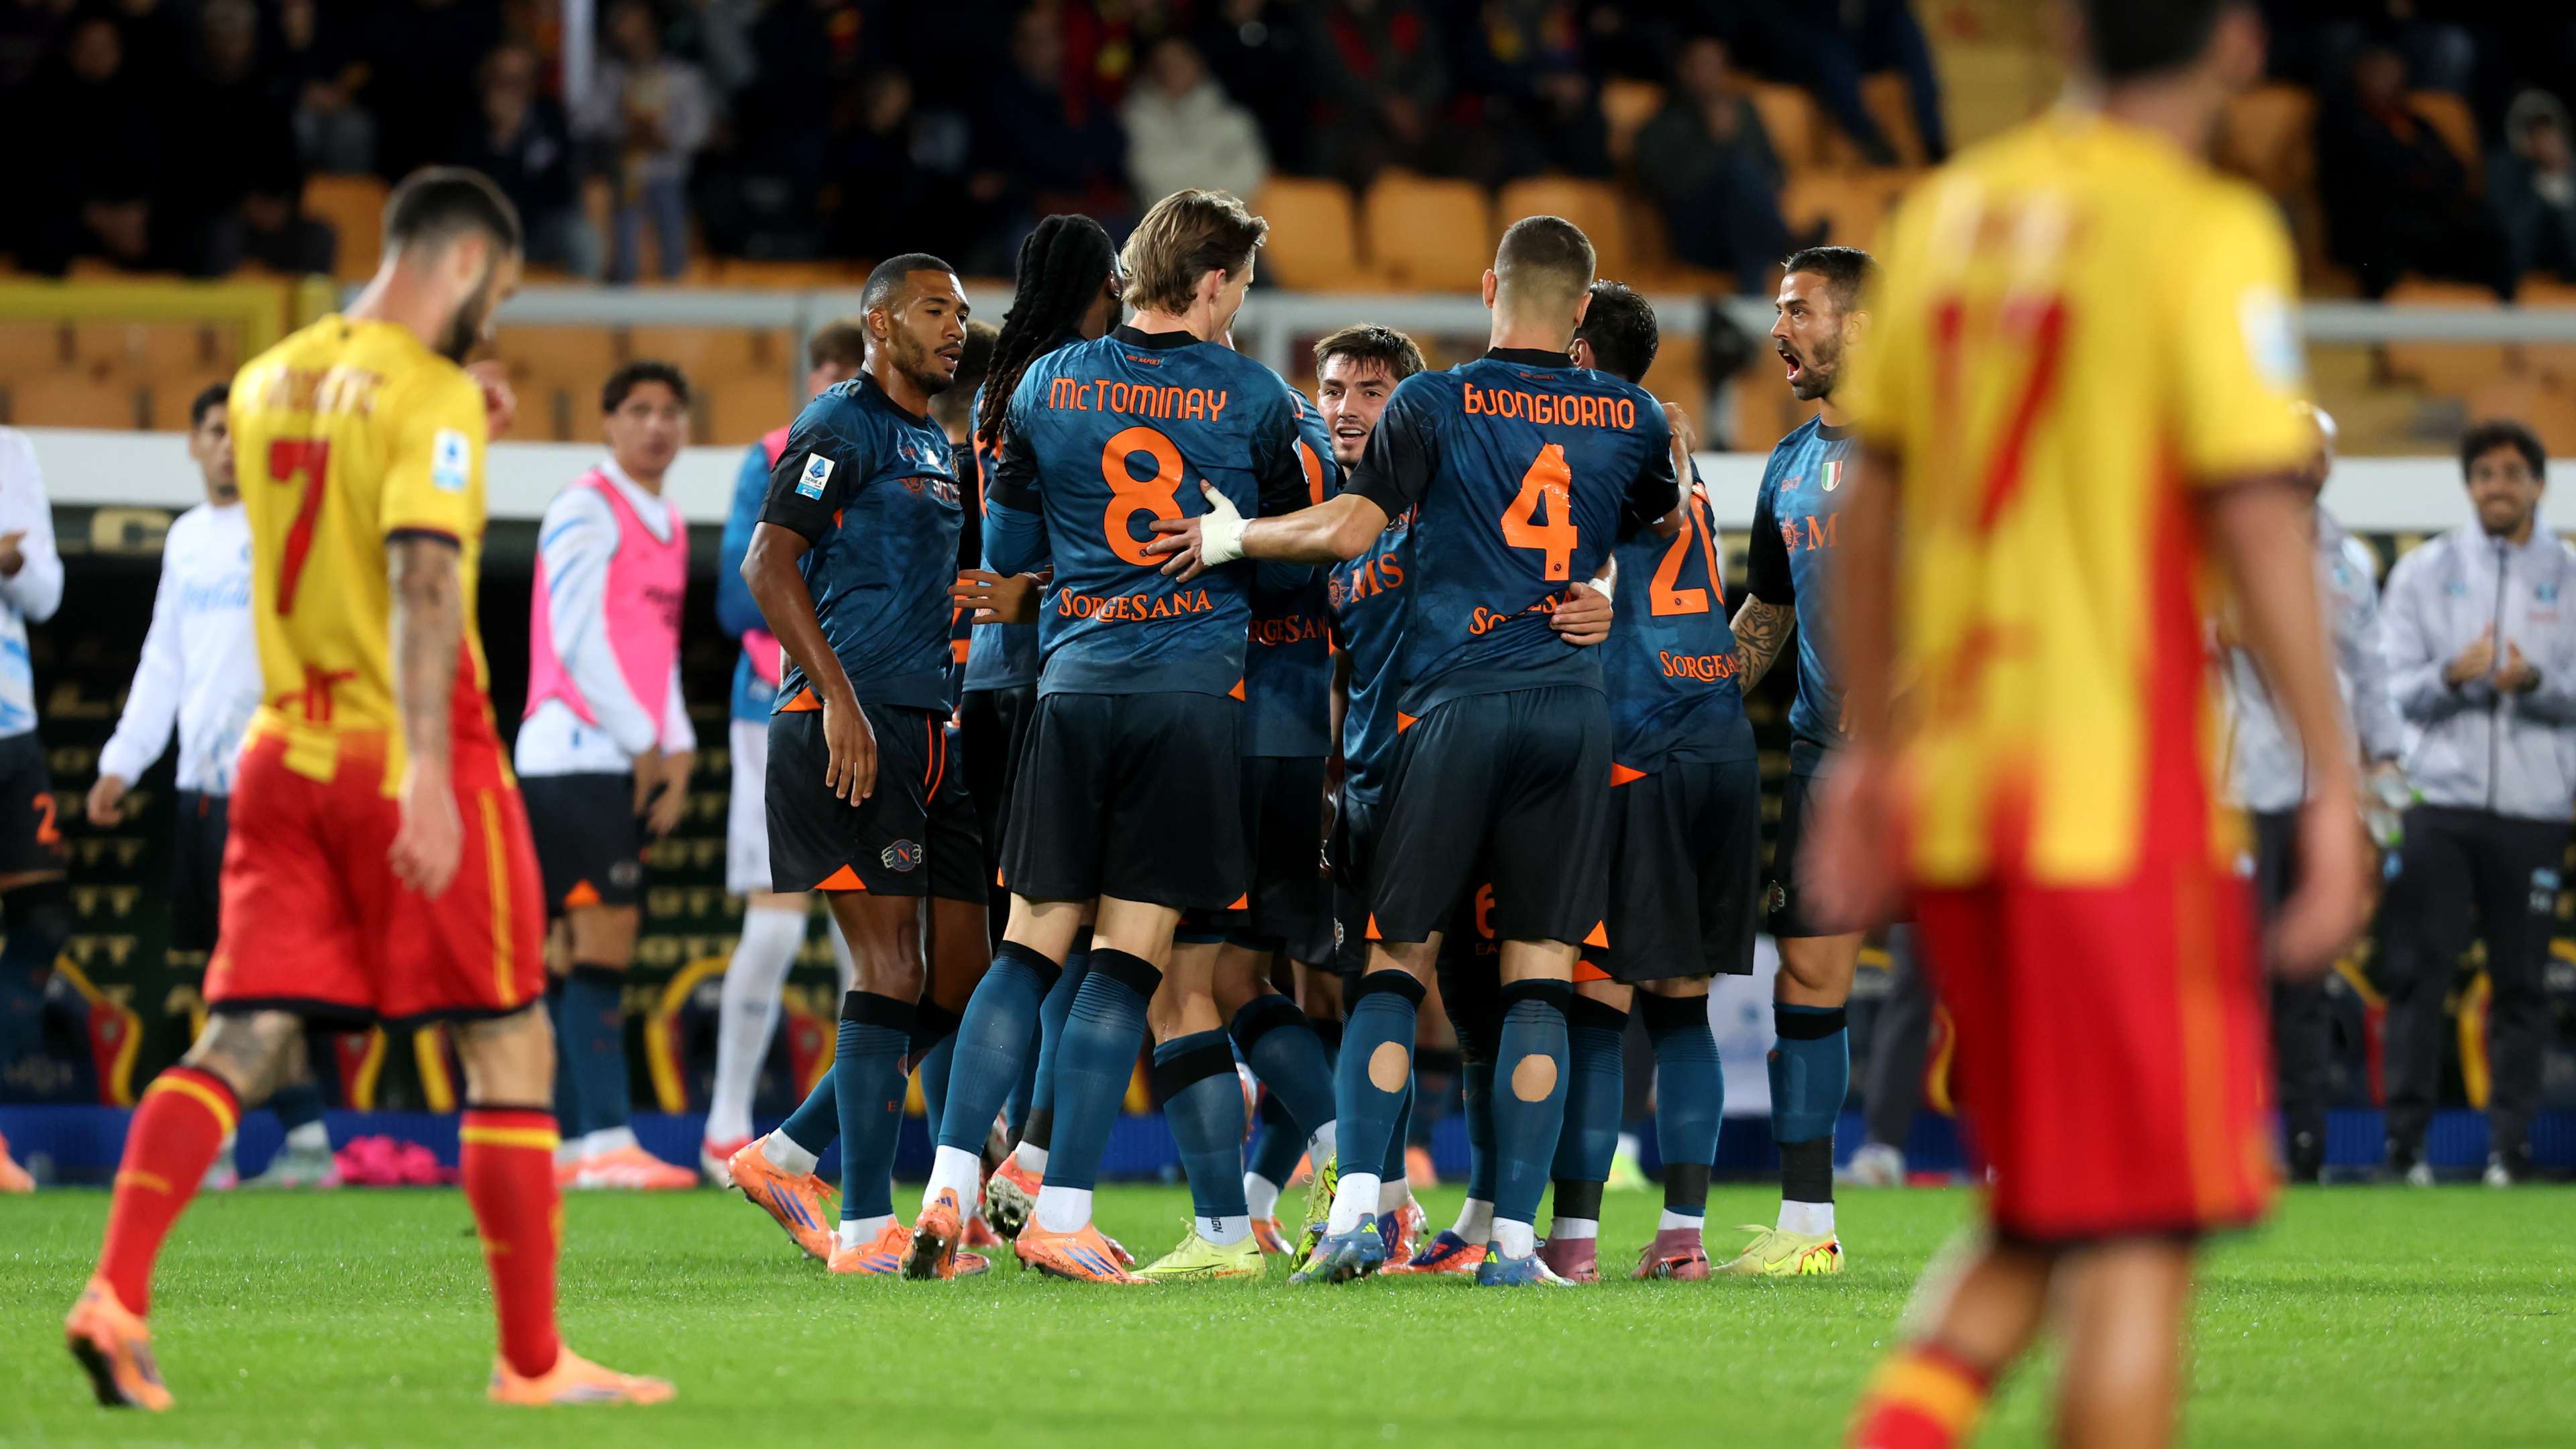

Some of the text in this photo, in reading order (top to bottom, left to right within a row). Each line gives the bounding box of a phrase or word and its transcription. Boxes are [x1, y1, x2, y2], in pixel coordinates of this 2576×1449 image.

[1464, 382, 1635, 430] BUONGIORNO
[1101, 425, 1184, 566] 8
[1500, 441, 1578, 581] 4
[270, 437, 331, 616] 7
[1351, 553, 1404, 603] MS
[1058, 586, 1214, 623] SORGESANA
[1248, 614, 1328, 646] RGESAN
[33, 793, 62, 846] 2
[1476, 943, 1497, 956] EA
